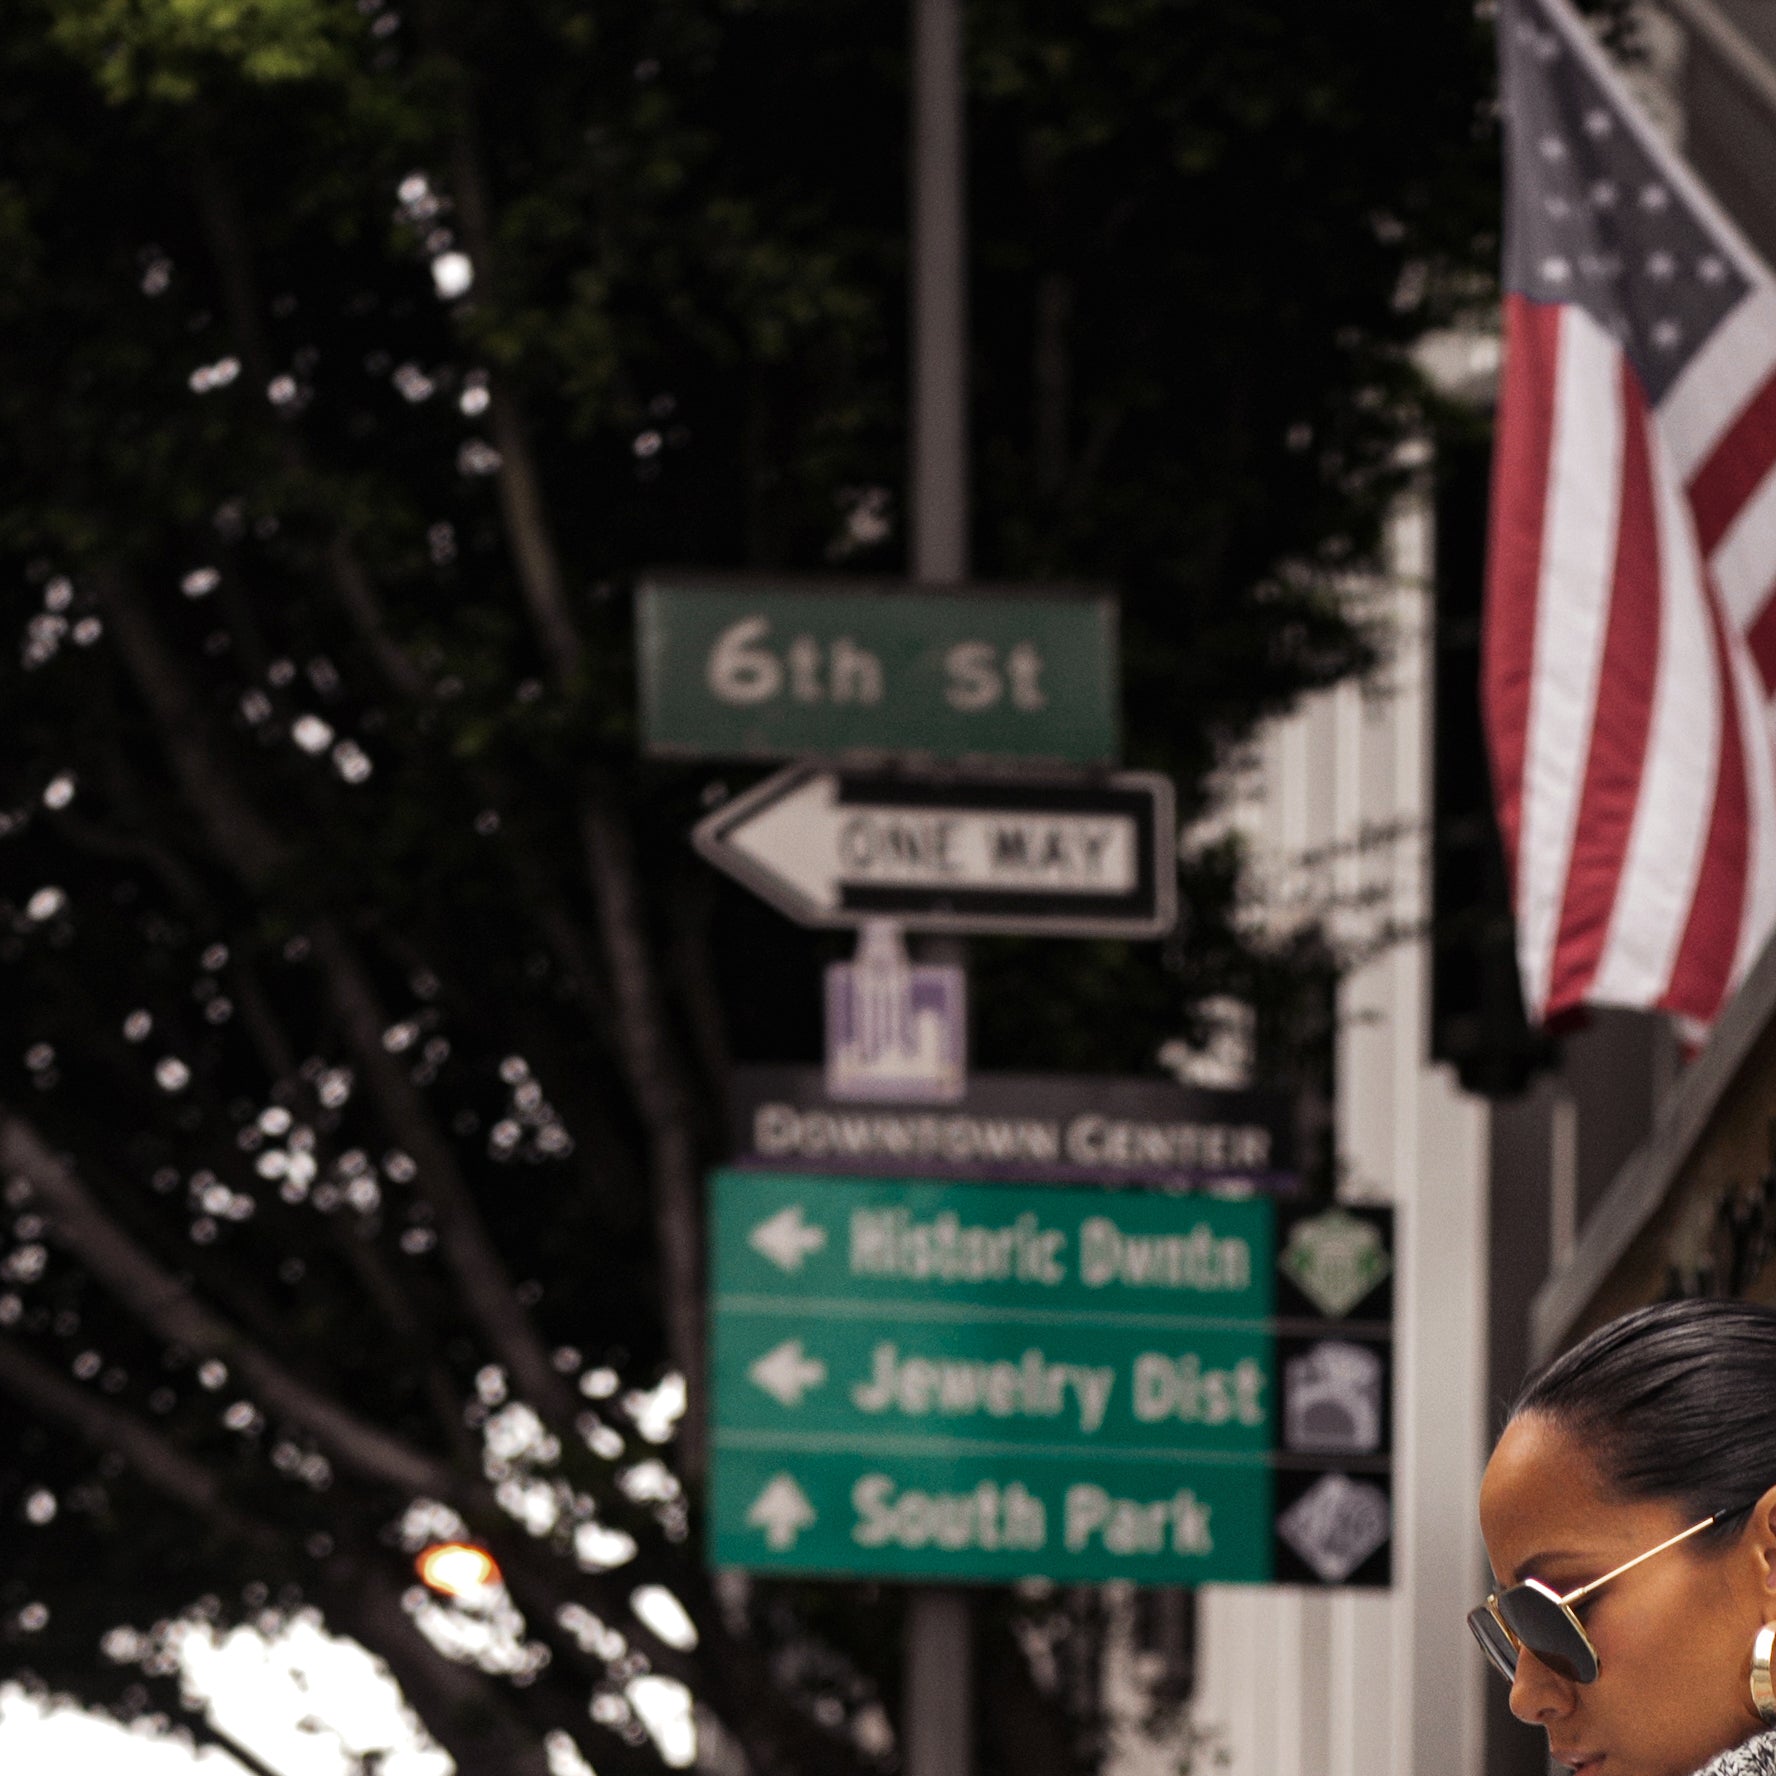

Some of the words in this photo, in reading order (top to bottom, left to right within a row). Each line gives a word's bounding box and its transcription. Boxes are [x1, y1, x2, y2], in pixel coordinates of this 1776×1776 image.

[706, 616, 884, 704] 6th
[943, 640, 1046, 711] St
[839, 816, 968, 876] ONE
[985, 816, 1114, 877] WAY
[849, 1206, 1067, 1286] Historic
[1079, 1216, 1251, 1292] Dwntn
[853, 1341, 1115, 1434] Jewelry
[1132, 1352, 1266, 1427] Dist
[851, 1473, 1048, 1552] South
[1064, 1482, 1213, 1558] Park
